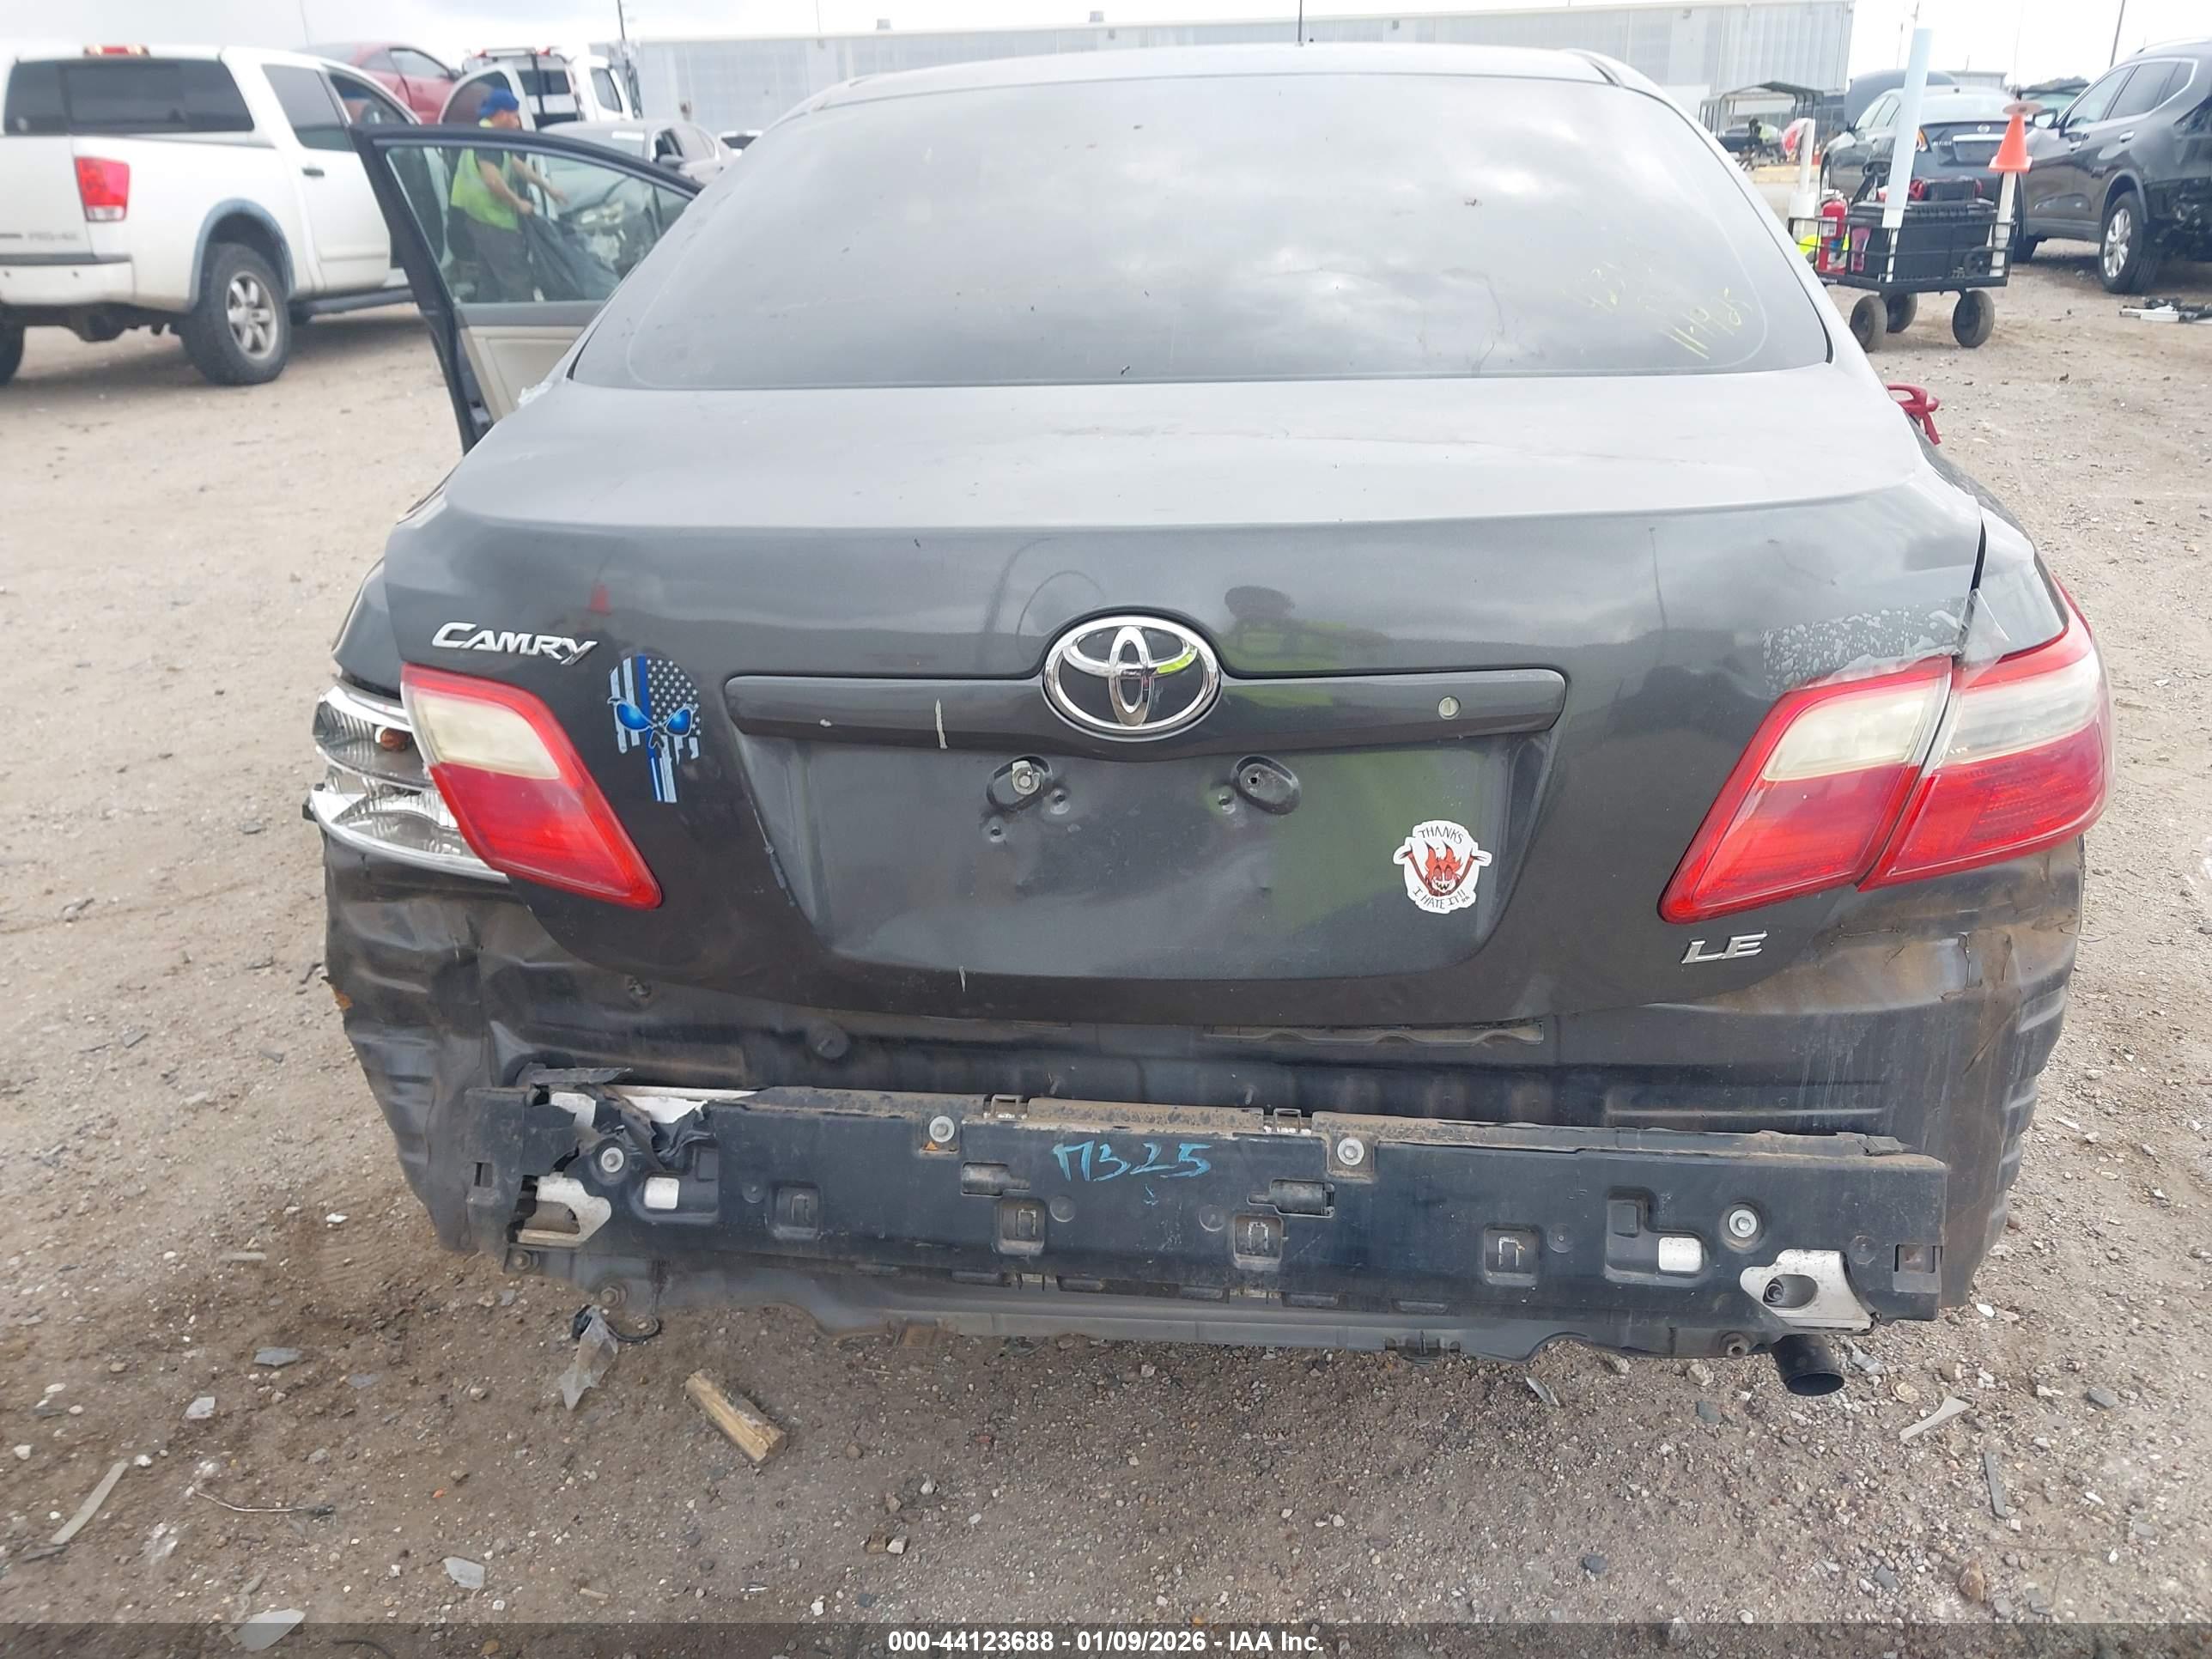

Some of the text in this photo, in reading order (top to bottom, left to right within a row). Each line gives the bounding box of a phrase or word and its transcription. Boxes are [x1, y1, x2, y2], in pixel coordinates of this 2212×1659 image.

[1417, 825, 1464, 845] THANKS
[1422, 894, 1446, 910] HATE
[1680, 929, 1769, 964] LE
